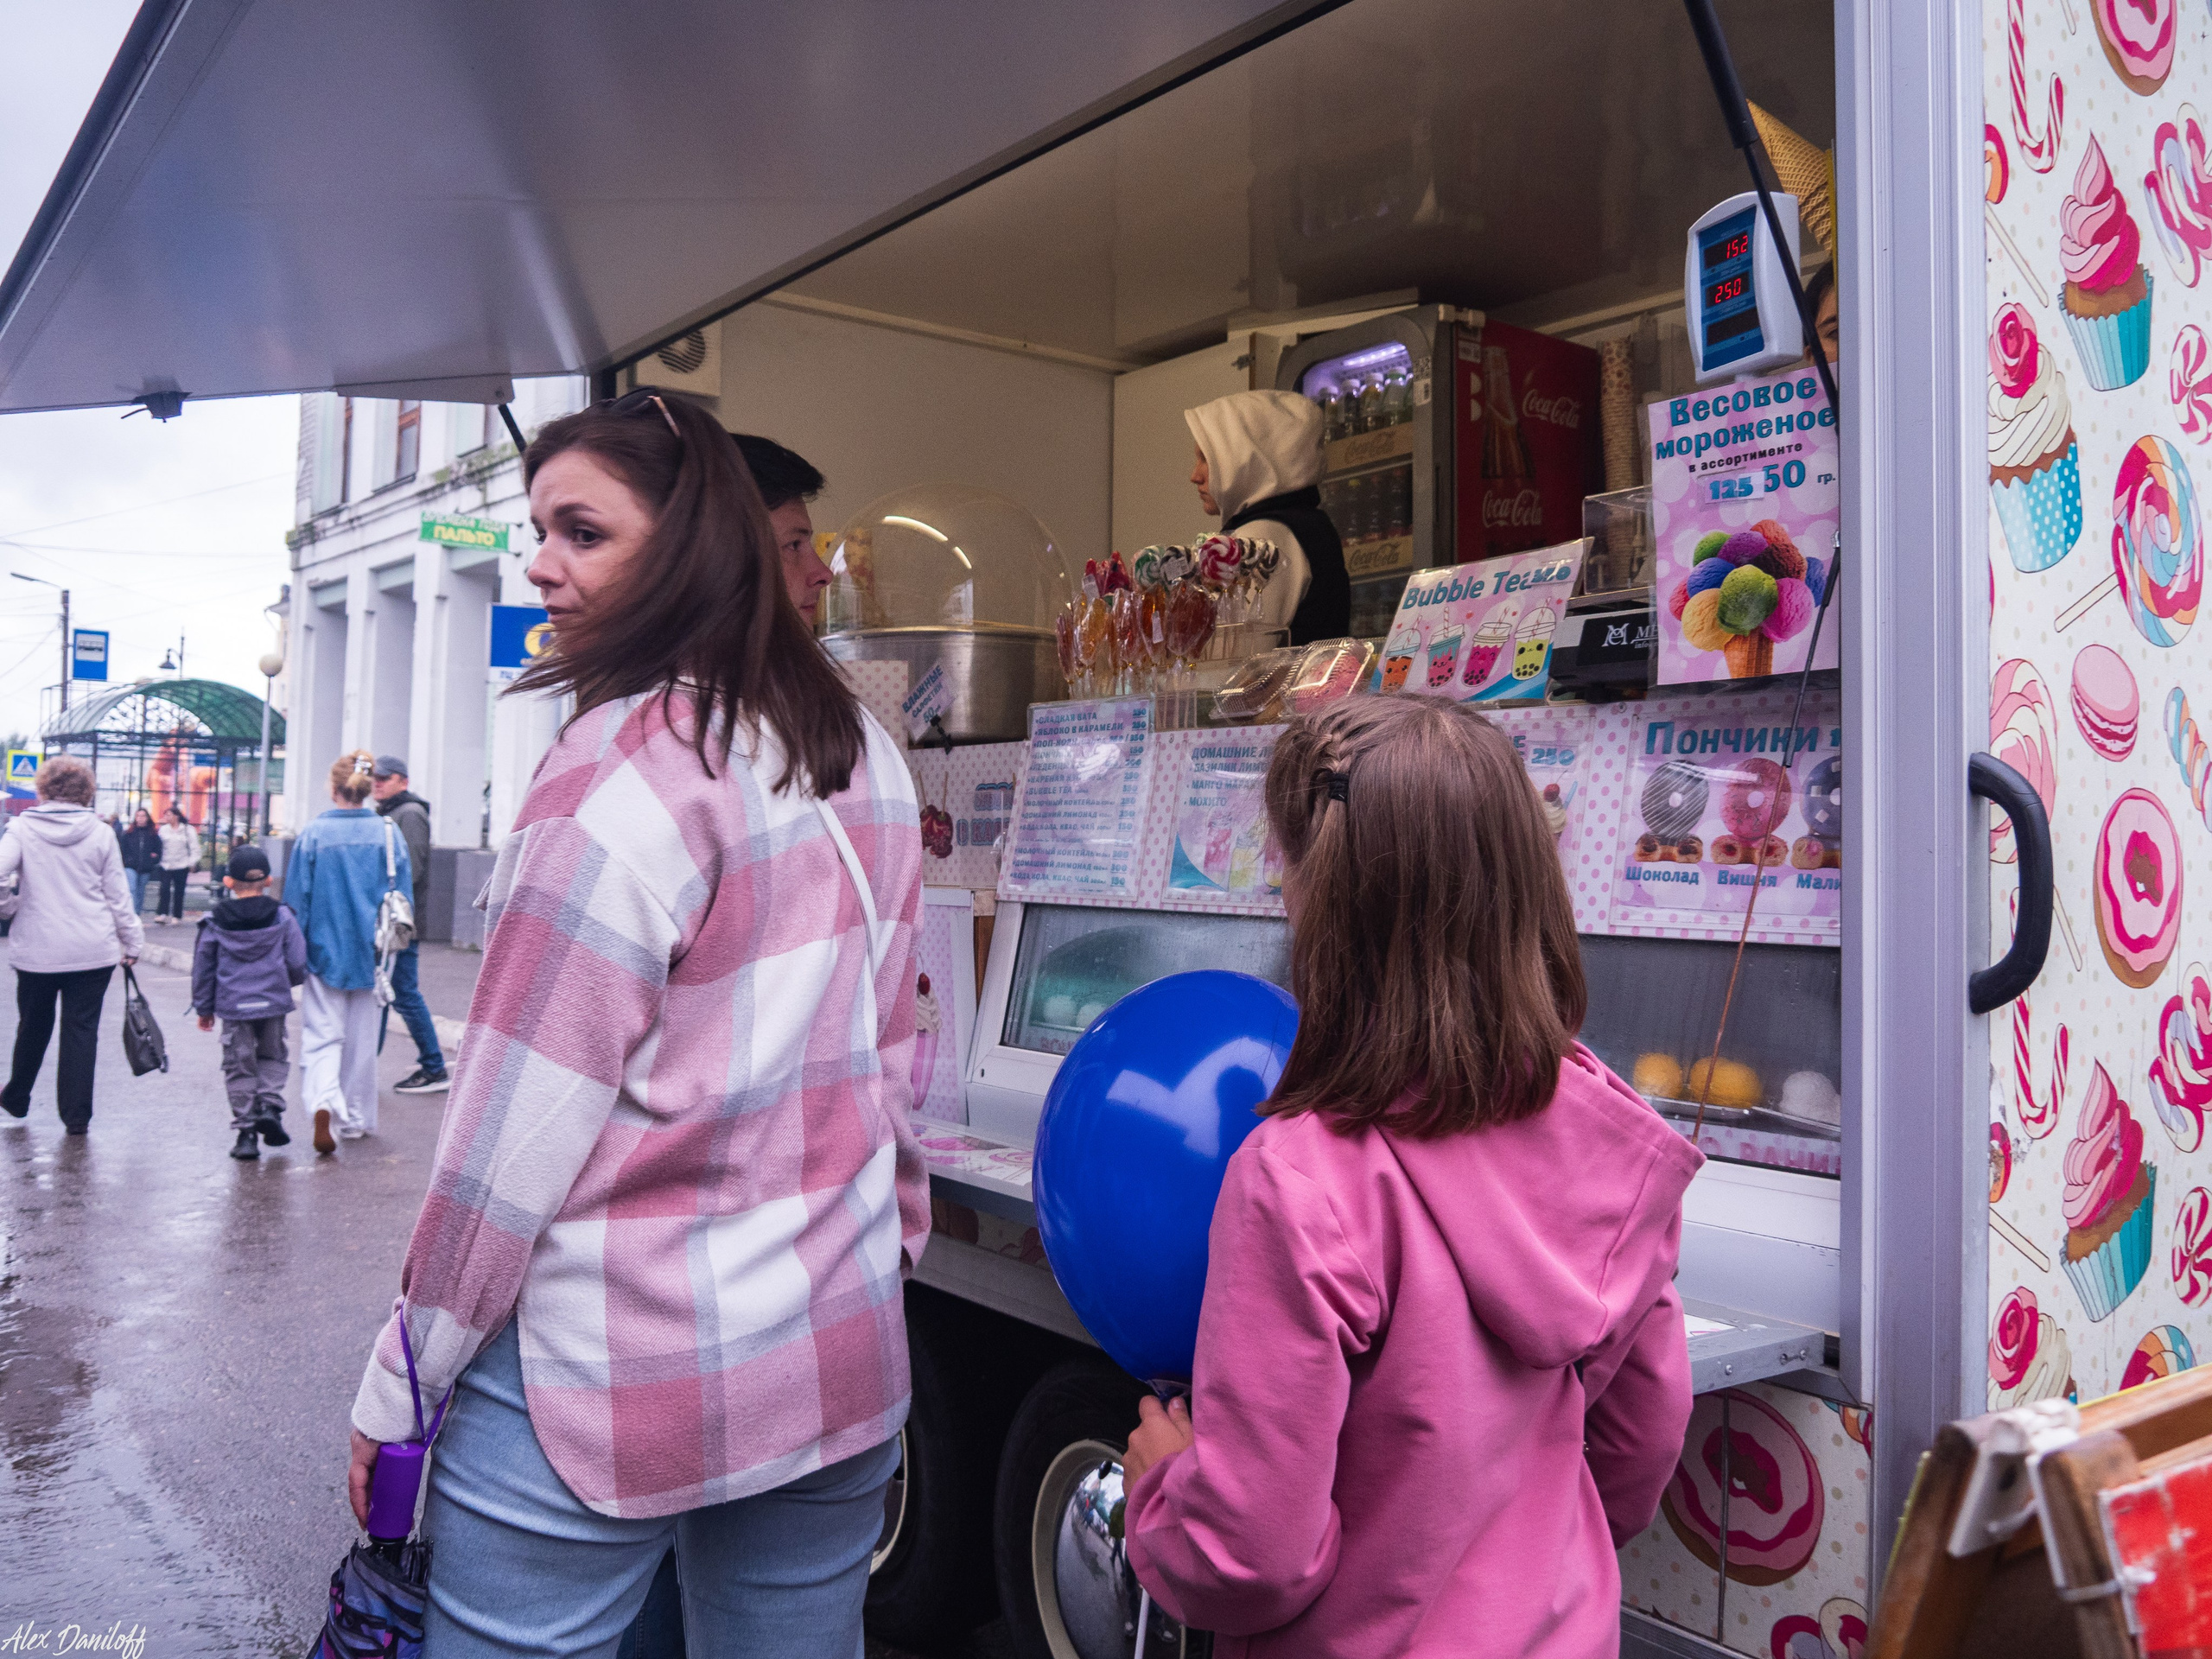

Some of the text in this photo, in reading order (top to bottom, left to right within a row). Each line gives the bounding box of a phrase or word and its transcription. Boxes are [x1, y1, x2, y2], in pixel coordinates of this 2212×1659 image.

[1726, 236, 1748, 259] 152
[1715, 277, 1742, 303] 250
[1669, 378, 1817, 427] Весовое
[1656, 407, 1836, 461] мороженое
[1688, 443, 1803, 473] в ассортименте
[1709, 460, 1836, 500] 125 50 гр.
[434, 524, 495, 546] ПАЛЬТО
[1402, 575, 1485, 610] Bubble
[902, 664, 944, 713] ВЛАЖНЫЕ
[1038, 713, 1076, 724] СЛАДКАЯ
[1077, 712, 1097, 721] ВАТА
[1038, 726, 1070, 736] ЯБЛОКО
[1078, 722, 1123, 733] КАРАМЕЛИ
[1645, 721, 1820, 754] Пончики
[1192, 747, 1258, 760] ДОМАШНИЕ
[1531, 748, 1575, 766] 250
[1194, 762, 1237, 772] БАЗИЛИК
[1192, 780, 1223, 789] МАНГО
[1057, 848, 1095, 857] КОКТЕЙЛЬ
[1014, 860, 1054, 868] ДОМАШНИЙ
[1055, 861, 1092, 871] ЛИМОНАД
[1075, 874, 1089, 883] ЧАЙ
[1625, 866, 1700, 886] Шоколад
[1717, 870, 1777, 887] Вишня
